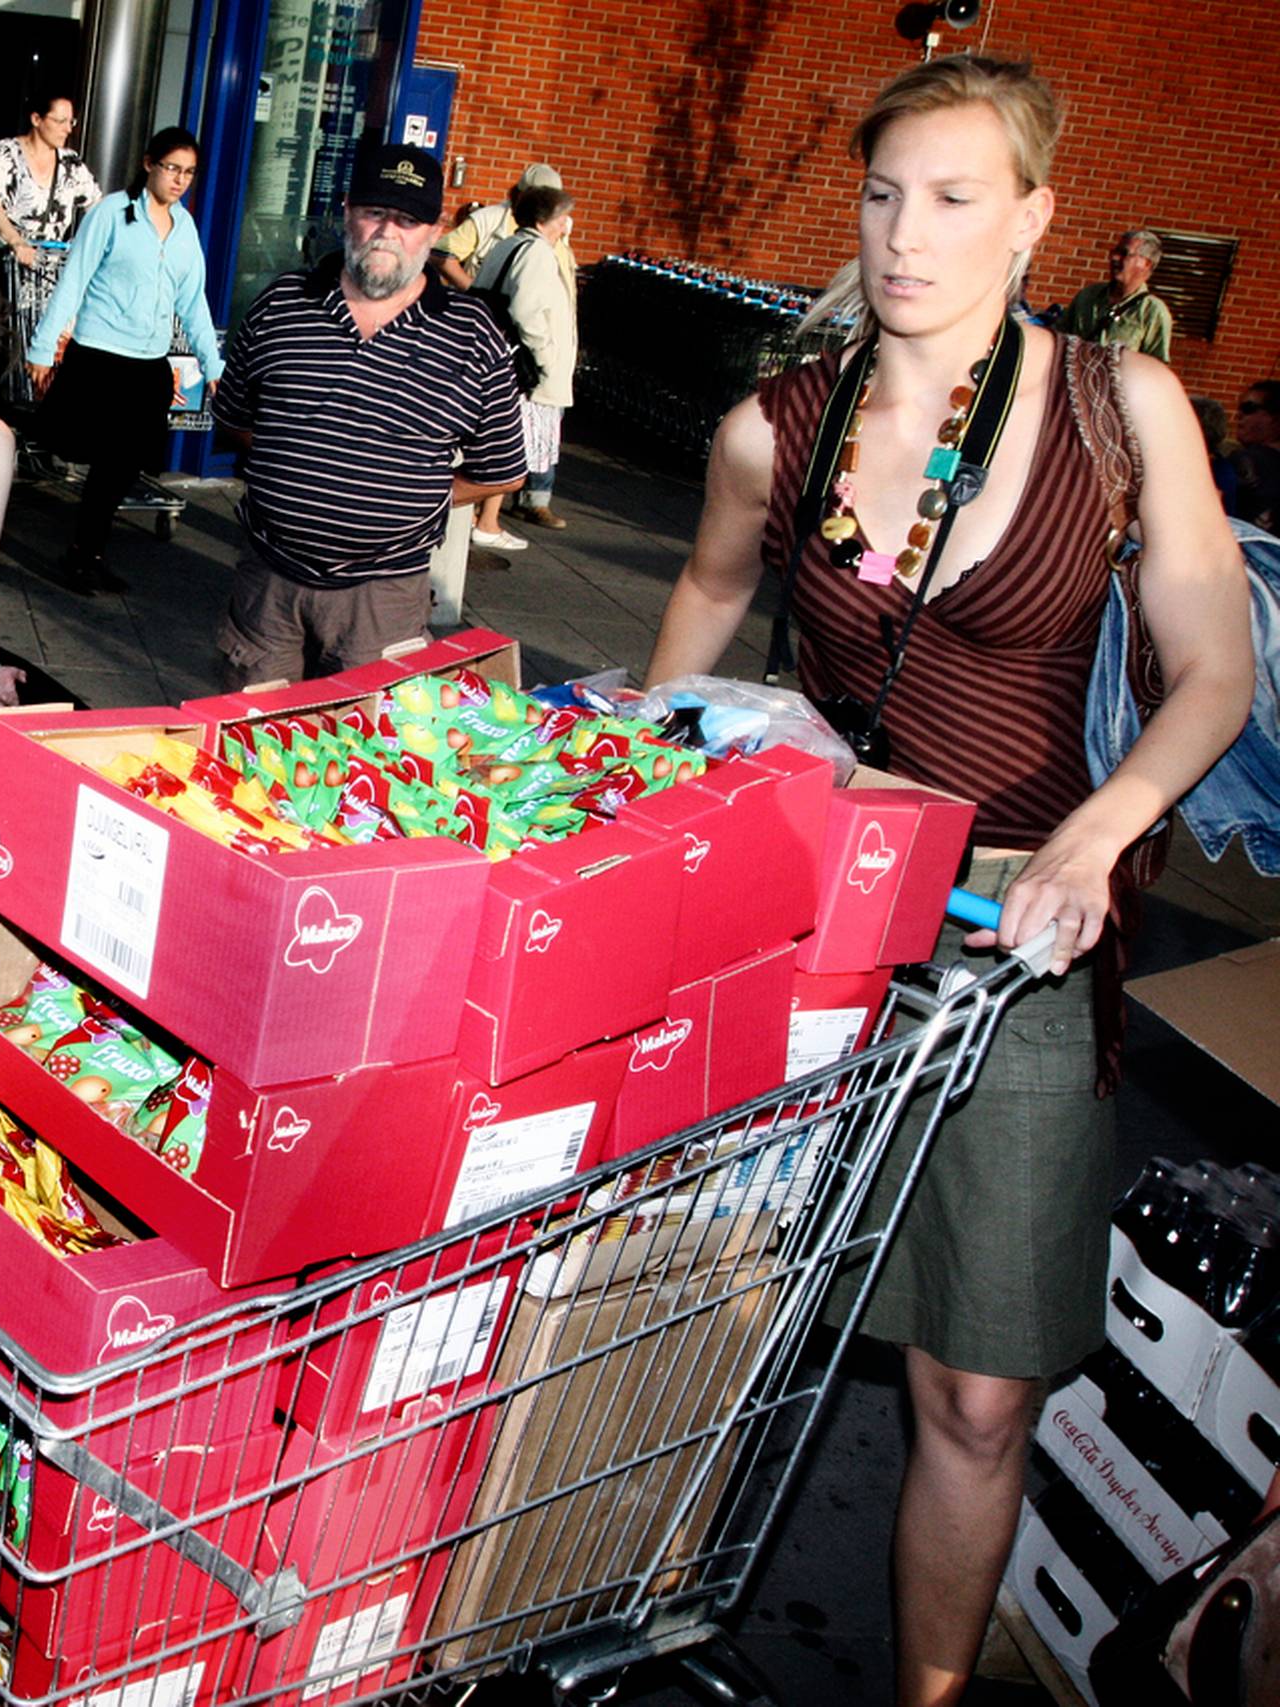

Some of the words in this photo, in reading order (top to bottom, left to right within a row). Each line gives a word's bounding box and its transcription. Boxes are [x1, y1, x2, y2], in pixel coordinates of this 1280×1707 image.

[859, 850, 891, 869] Malaco
[301, 918, 356, 946] Malaco
[640, 1028, 686, 1054] Malaco
[113, 1322, 167, 1349] Malaco
[1137, 1512, 1184, 1567] Sverige
